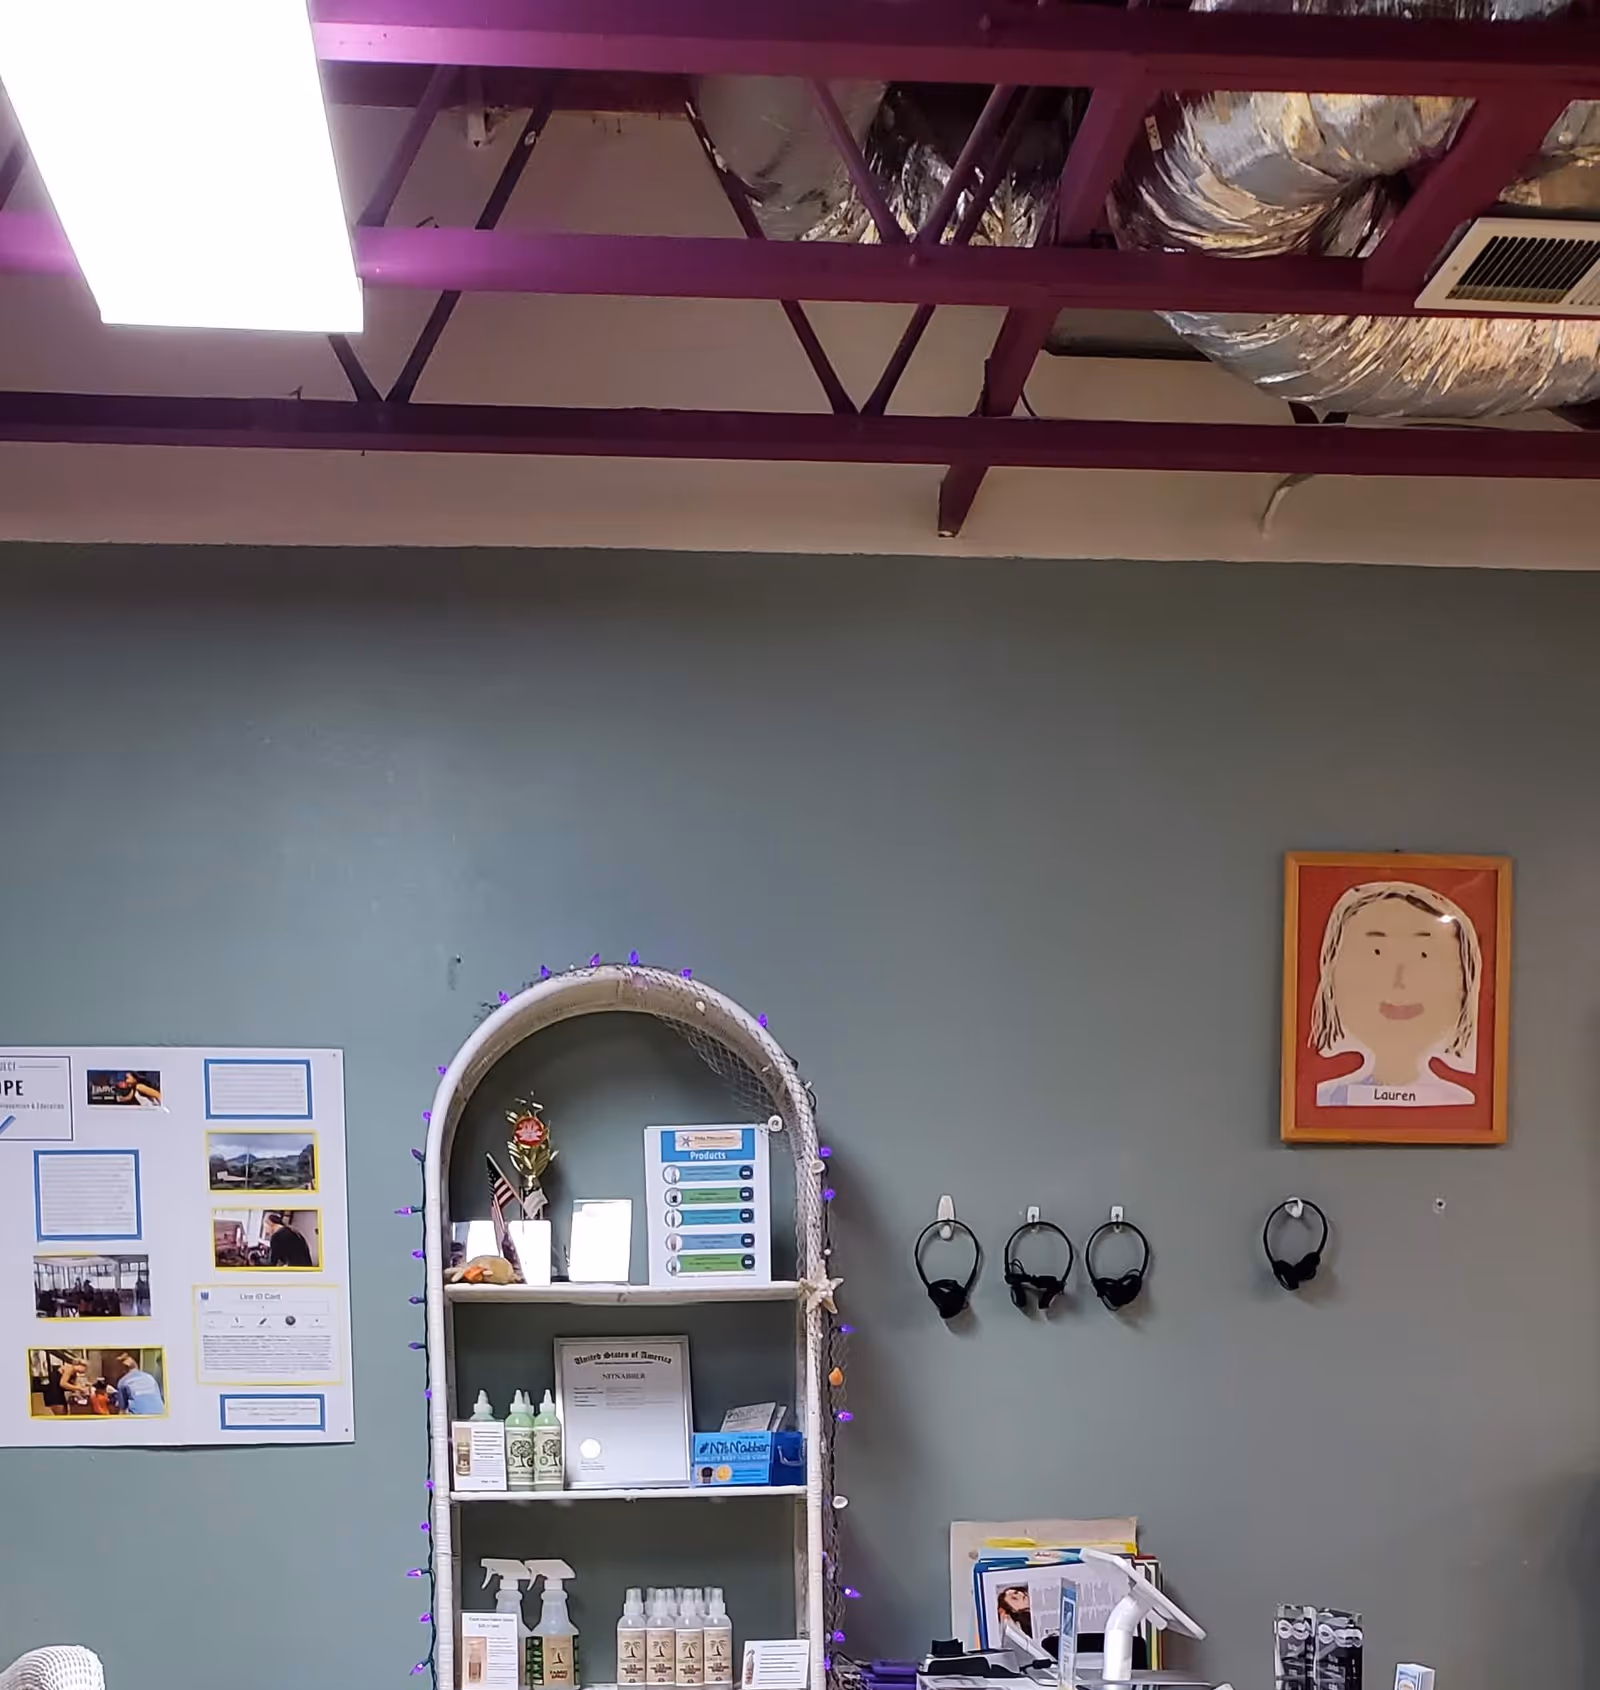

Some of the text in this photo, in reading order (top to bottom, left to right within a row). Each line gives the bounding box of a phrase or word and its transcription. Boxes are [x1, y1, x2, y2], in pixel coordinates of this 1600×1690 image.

[0, 1079, 24, 1097] PE
[1374, 1088, 1416, 1102] Lauren
[690, 1151, 727, 1160] Products
[574, 1352, 602, 1365] United
[603, 1351, 629, 1359] States
[631, 1350, 639, 1359] of
[640, 1350, 673, 1365] America
